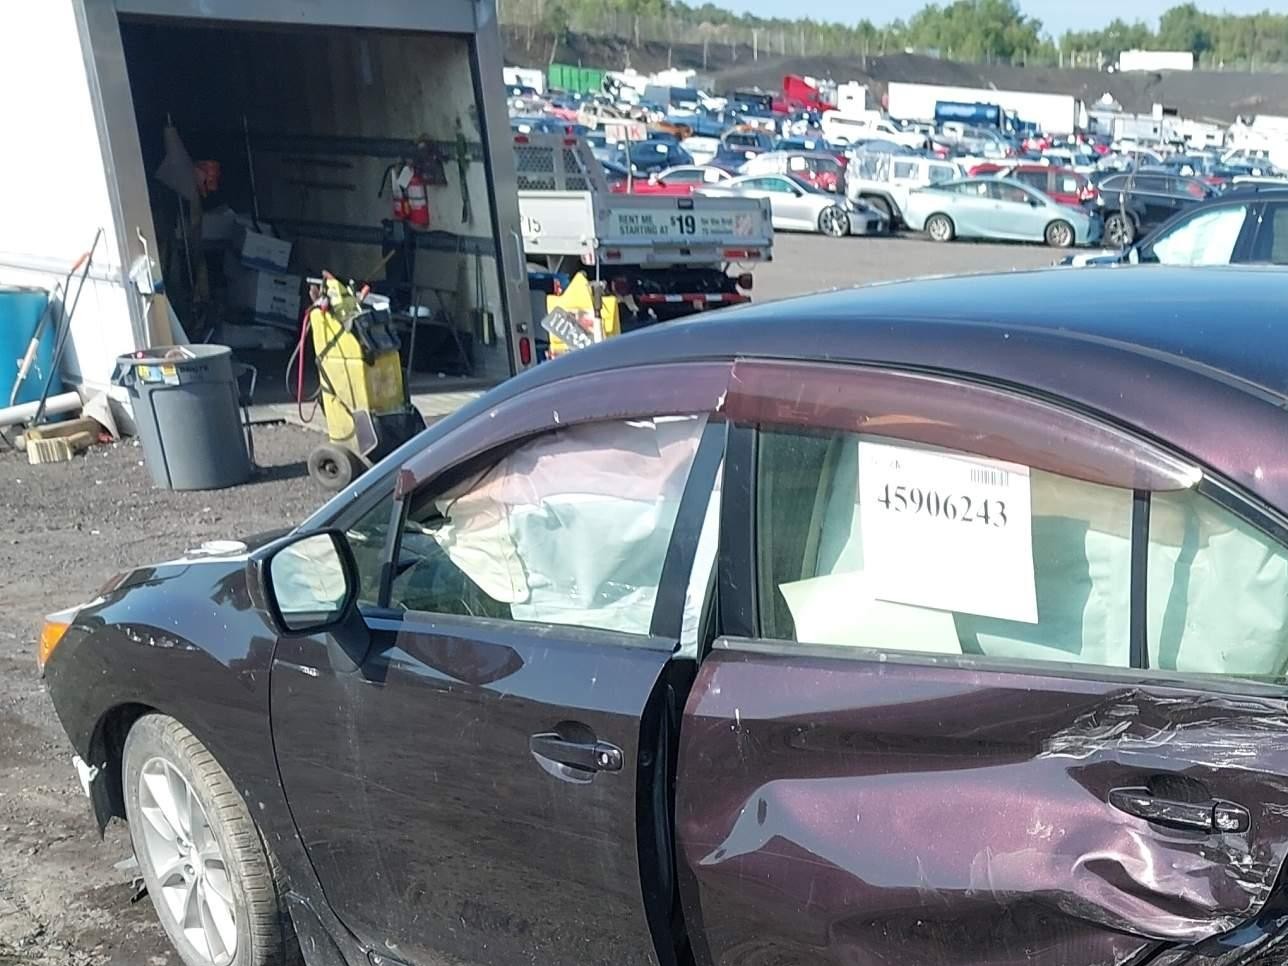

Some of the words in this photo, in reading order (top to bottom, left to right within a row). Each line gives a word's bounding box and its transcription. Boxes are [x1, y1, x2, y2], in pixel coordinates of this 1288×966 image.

[618, 214, 640, 225] RENT
[641, 214, 653, 225] ME
[670, 214, 696, 235] $19
[619, 225, 658, 236] STARTING
[659, 225, 669, 235] AT
[877, 482, 1008, 528] 45906243
